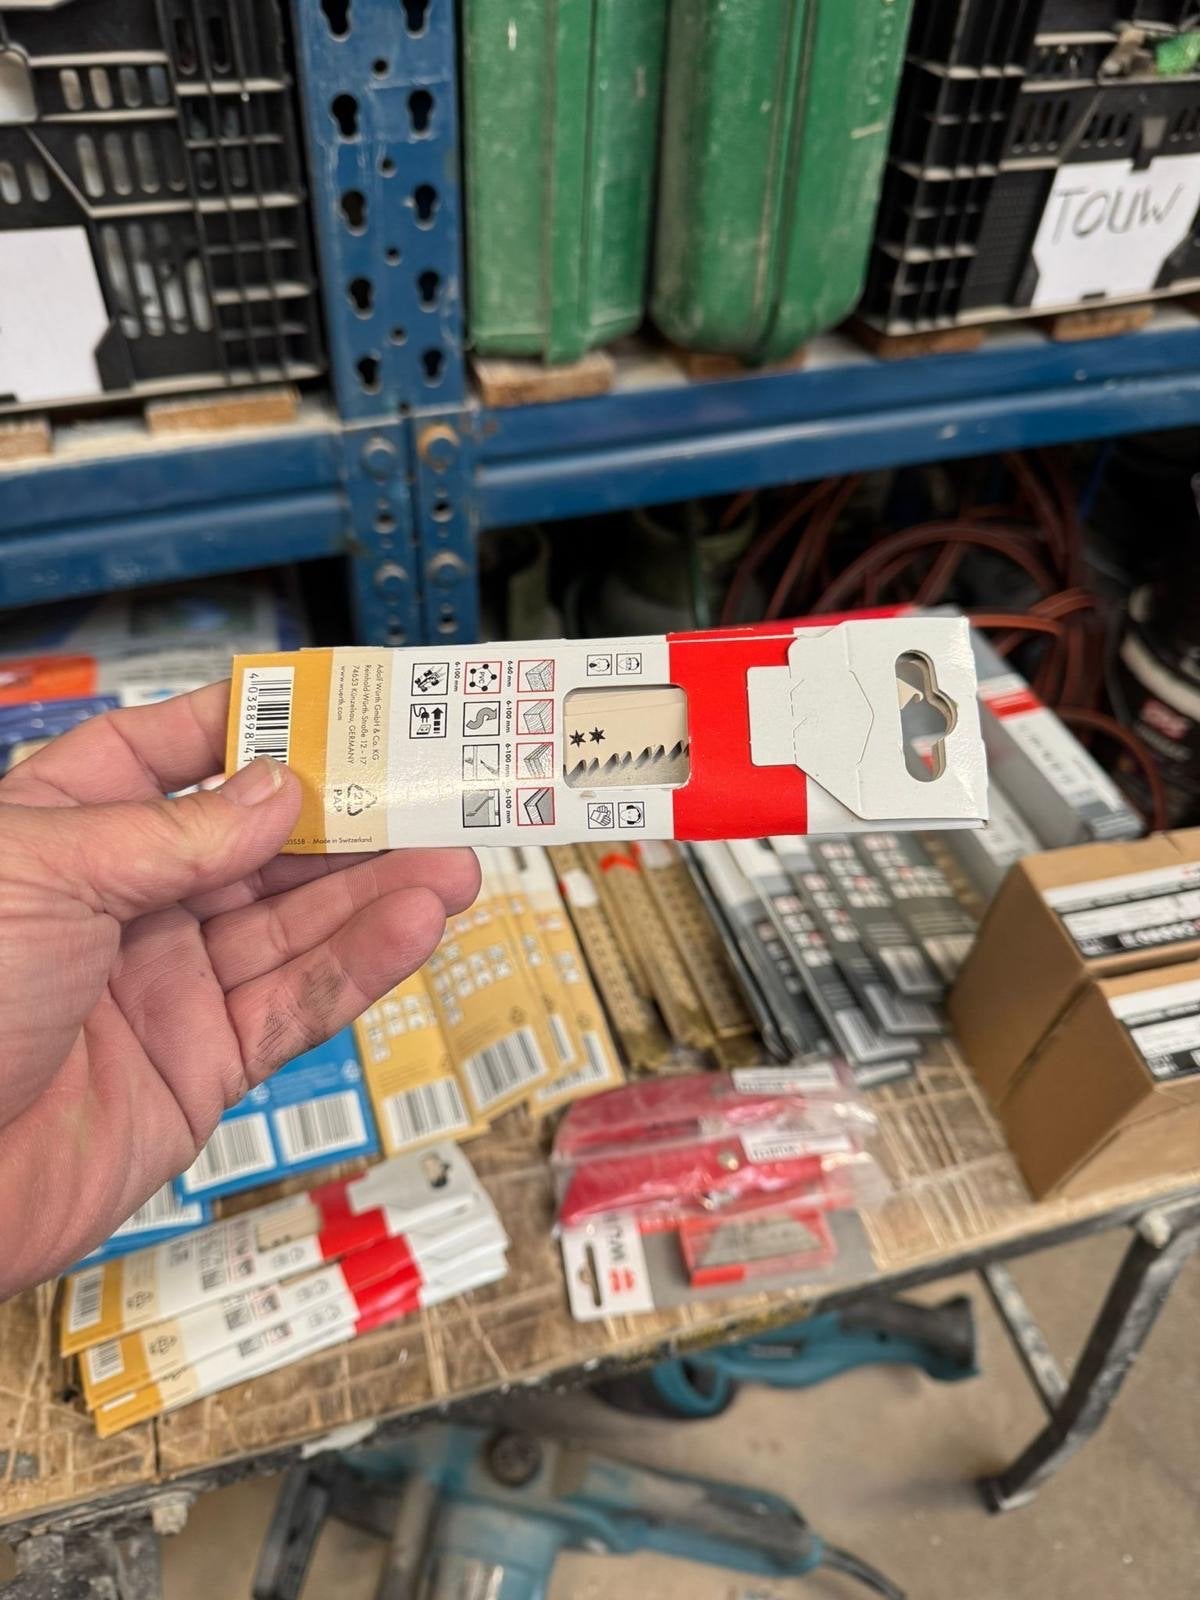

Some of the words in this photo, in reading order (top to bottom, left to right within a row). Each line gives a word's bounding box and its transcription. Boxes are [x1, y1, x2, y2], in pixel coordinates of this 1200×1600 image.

[1051, 183, 1185, 246] TOUW
[351, 664, 360, 687] 74653
[375, 664, 384, 682] Adolf
[506, 675, 512, 687] mm
[244, 686, 259, 739] 038898
[372, 704, 381, 727] GmbH
[505, 700, 513, 720] 6-100
[505, 720, 511, 733] mm
[346, 724, 356, 765] GERMANY
[360, 740, 368, 749] 12
[359, 756, 367, 765] 17
[371, 749, 379, 761] KG
[333, 788, 343, 813] PAP
[506, 810, 511, 824] mm
[338, 835, 373, 844] Switzerland
